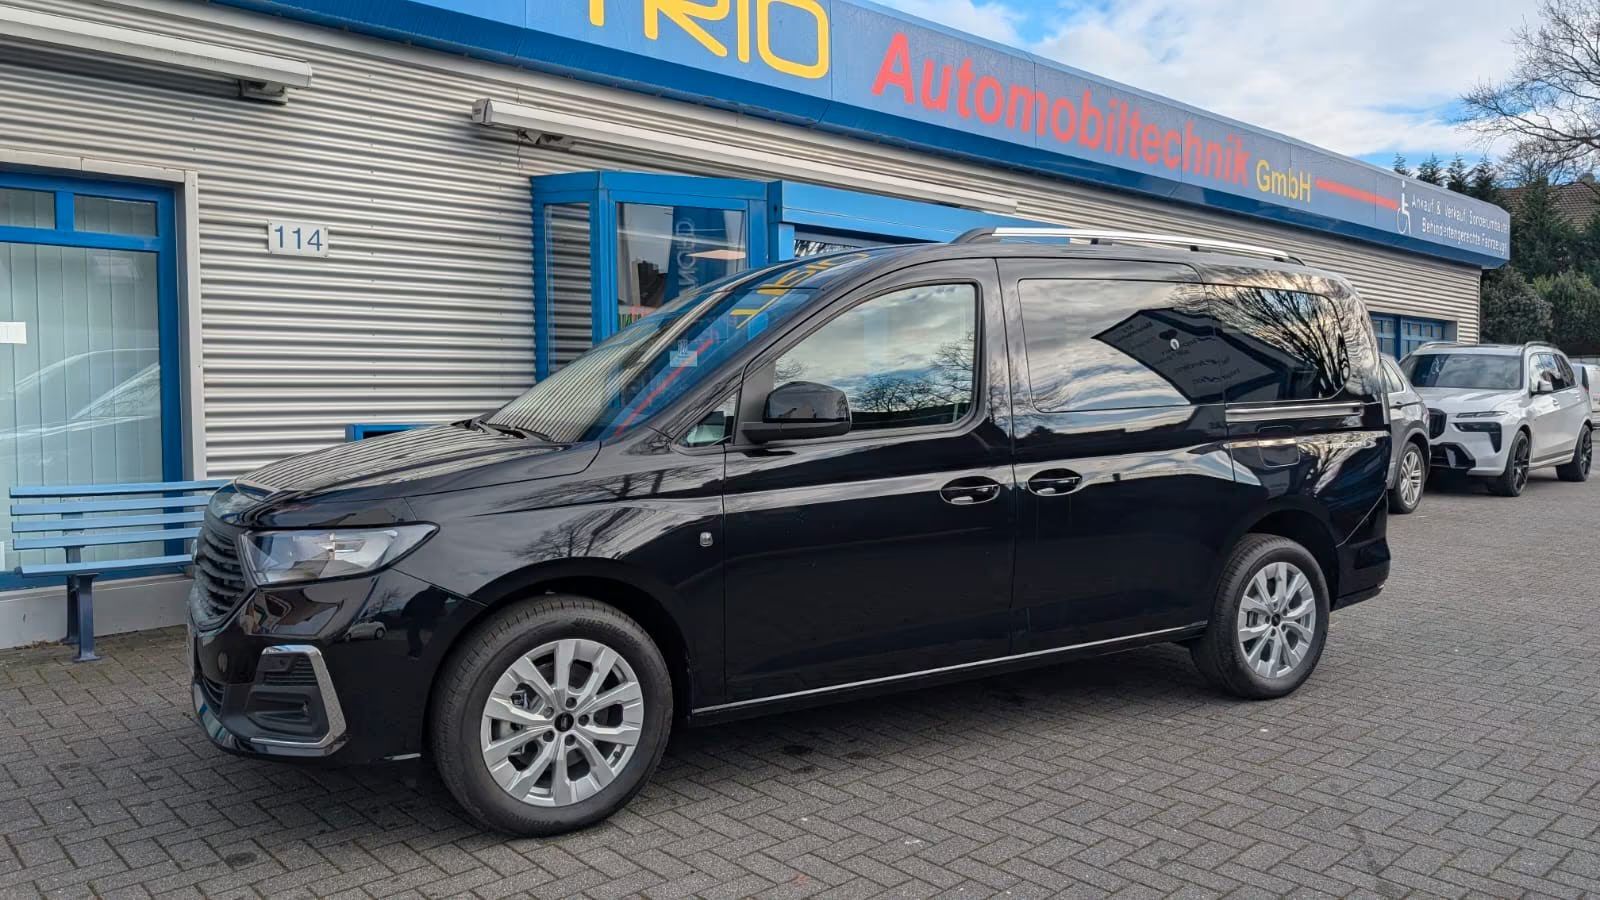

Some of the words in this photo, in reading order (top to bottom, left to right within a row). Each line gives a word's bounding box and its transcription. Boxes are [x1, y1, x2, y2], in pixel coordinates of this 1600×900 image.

[872, 33, 1251, 187] Automobiltechnik
[1256, 160, 1311, 202] GmbH
[274, 225, 323, 252] 114
